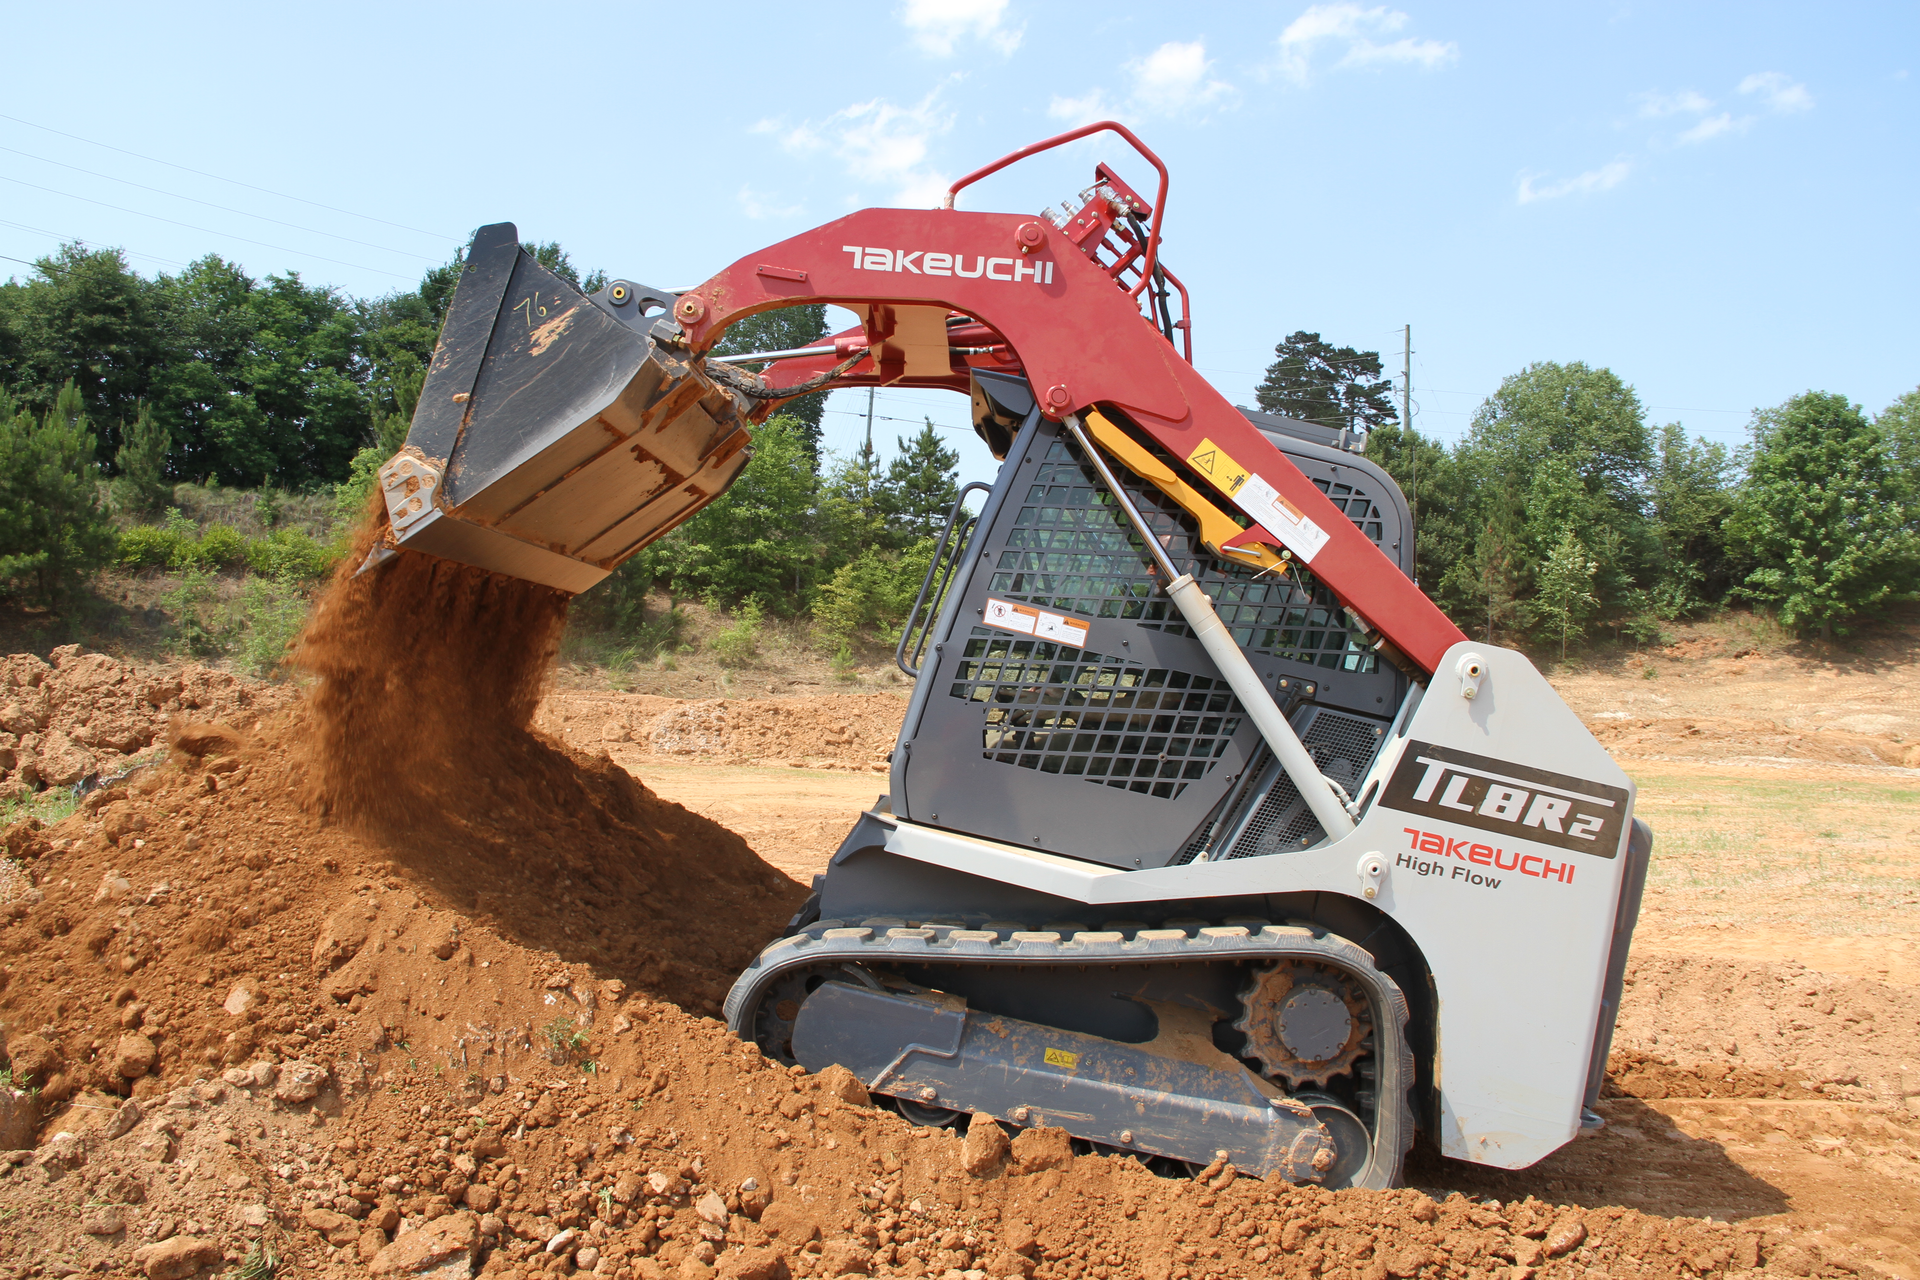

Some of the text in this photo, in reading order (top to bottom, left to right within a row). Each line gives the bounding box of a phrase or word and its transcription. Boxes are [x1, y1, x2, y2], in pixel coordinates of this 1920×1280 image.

[513, 291, 547, 327] 76
[1412, 755, 1616, 841] TL8R2
[1395, 853, 1502, 889] High Flow
